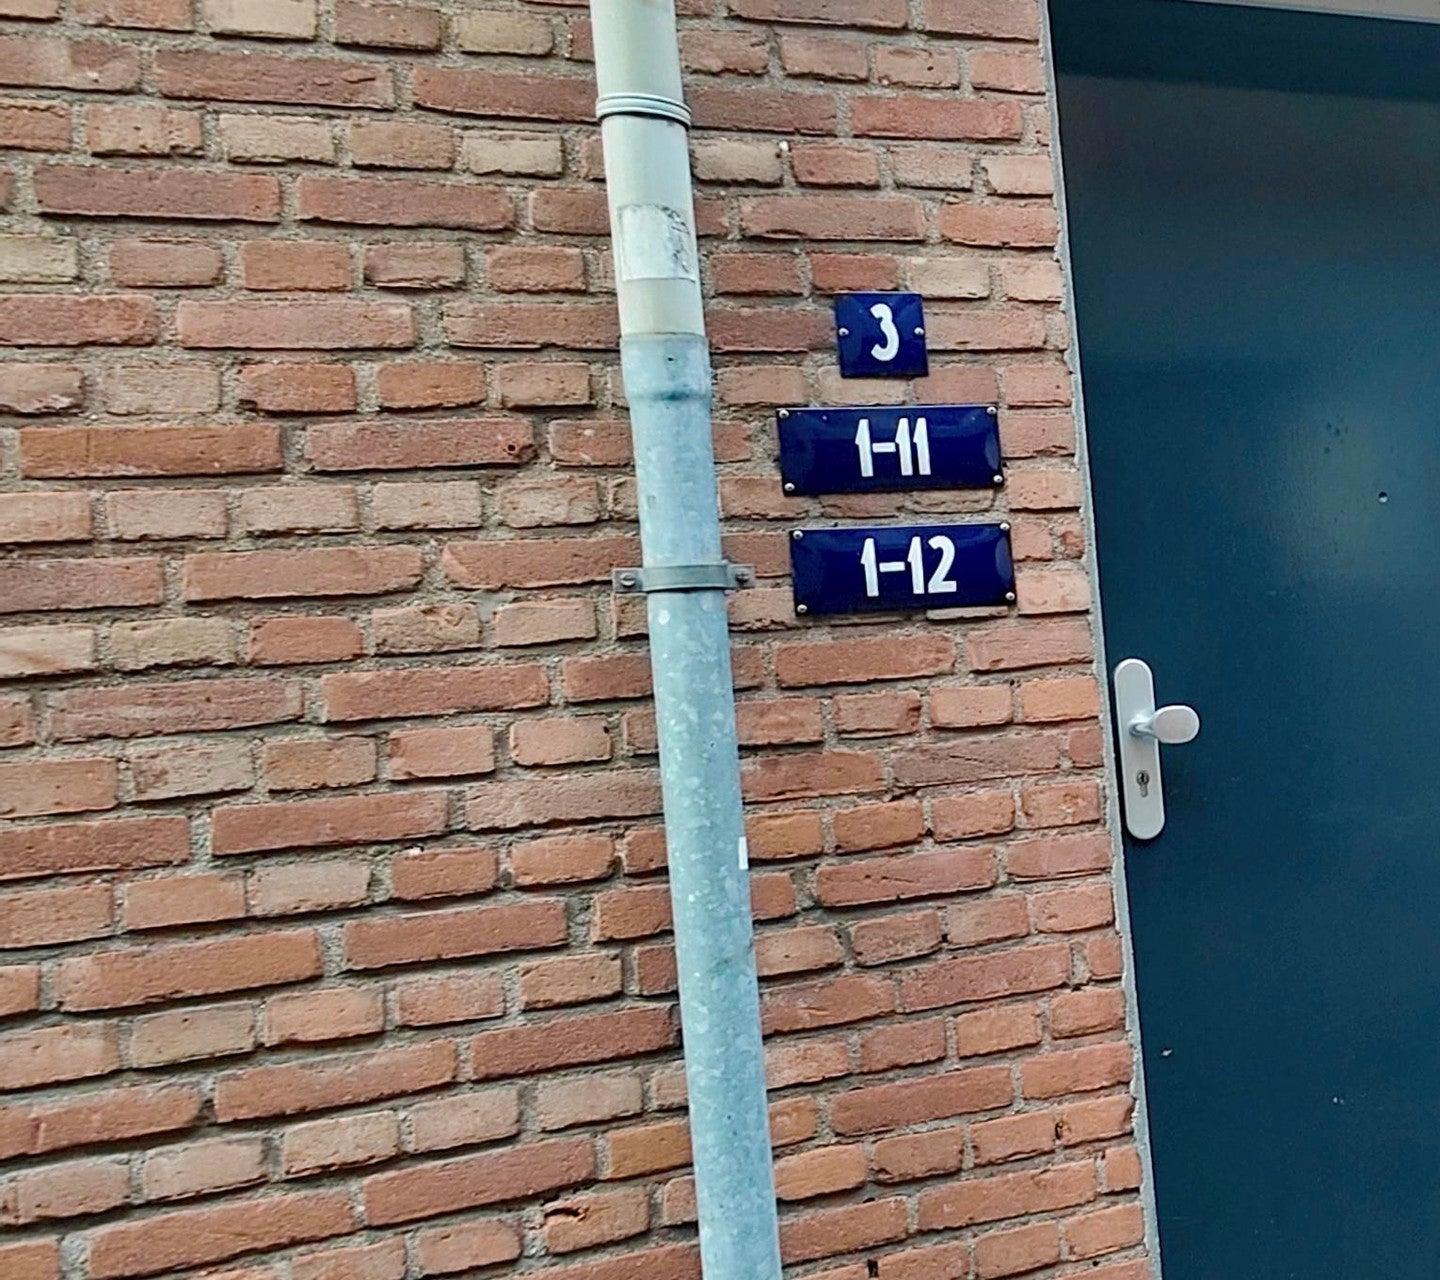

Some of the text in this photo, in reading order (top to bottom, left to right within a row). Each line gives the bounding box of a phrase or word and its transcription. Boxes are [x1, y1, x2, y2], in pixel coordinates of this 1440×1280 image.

[869, 303, 900, 362] 3
[854, 417, 932, 478] 1-11
[860, 535, 958, 597] 1-12
